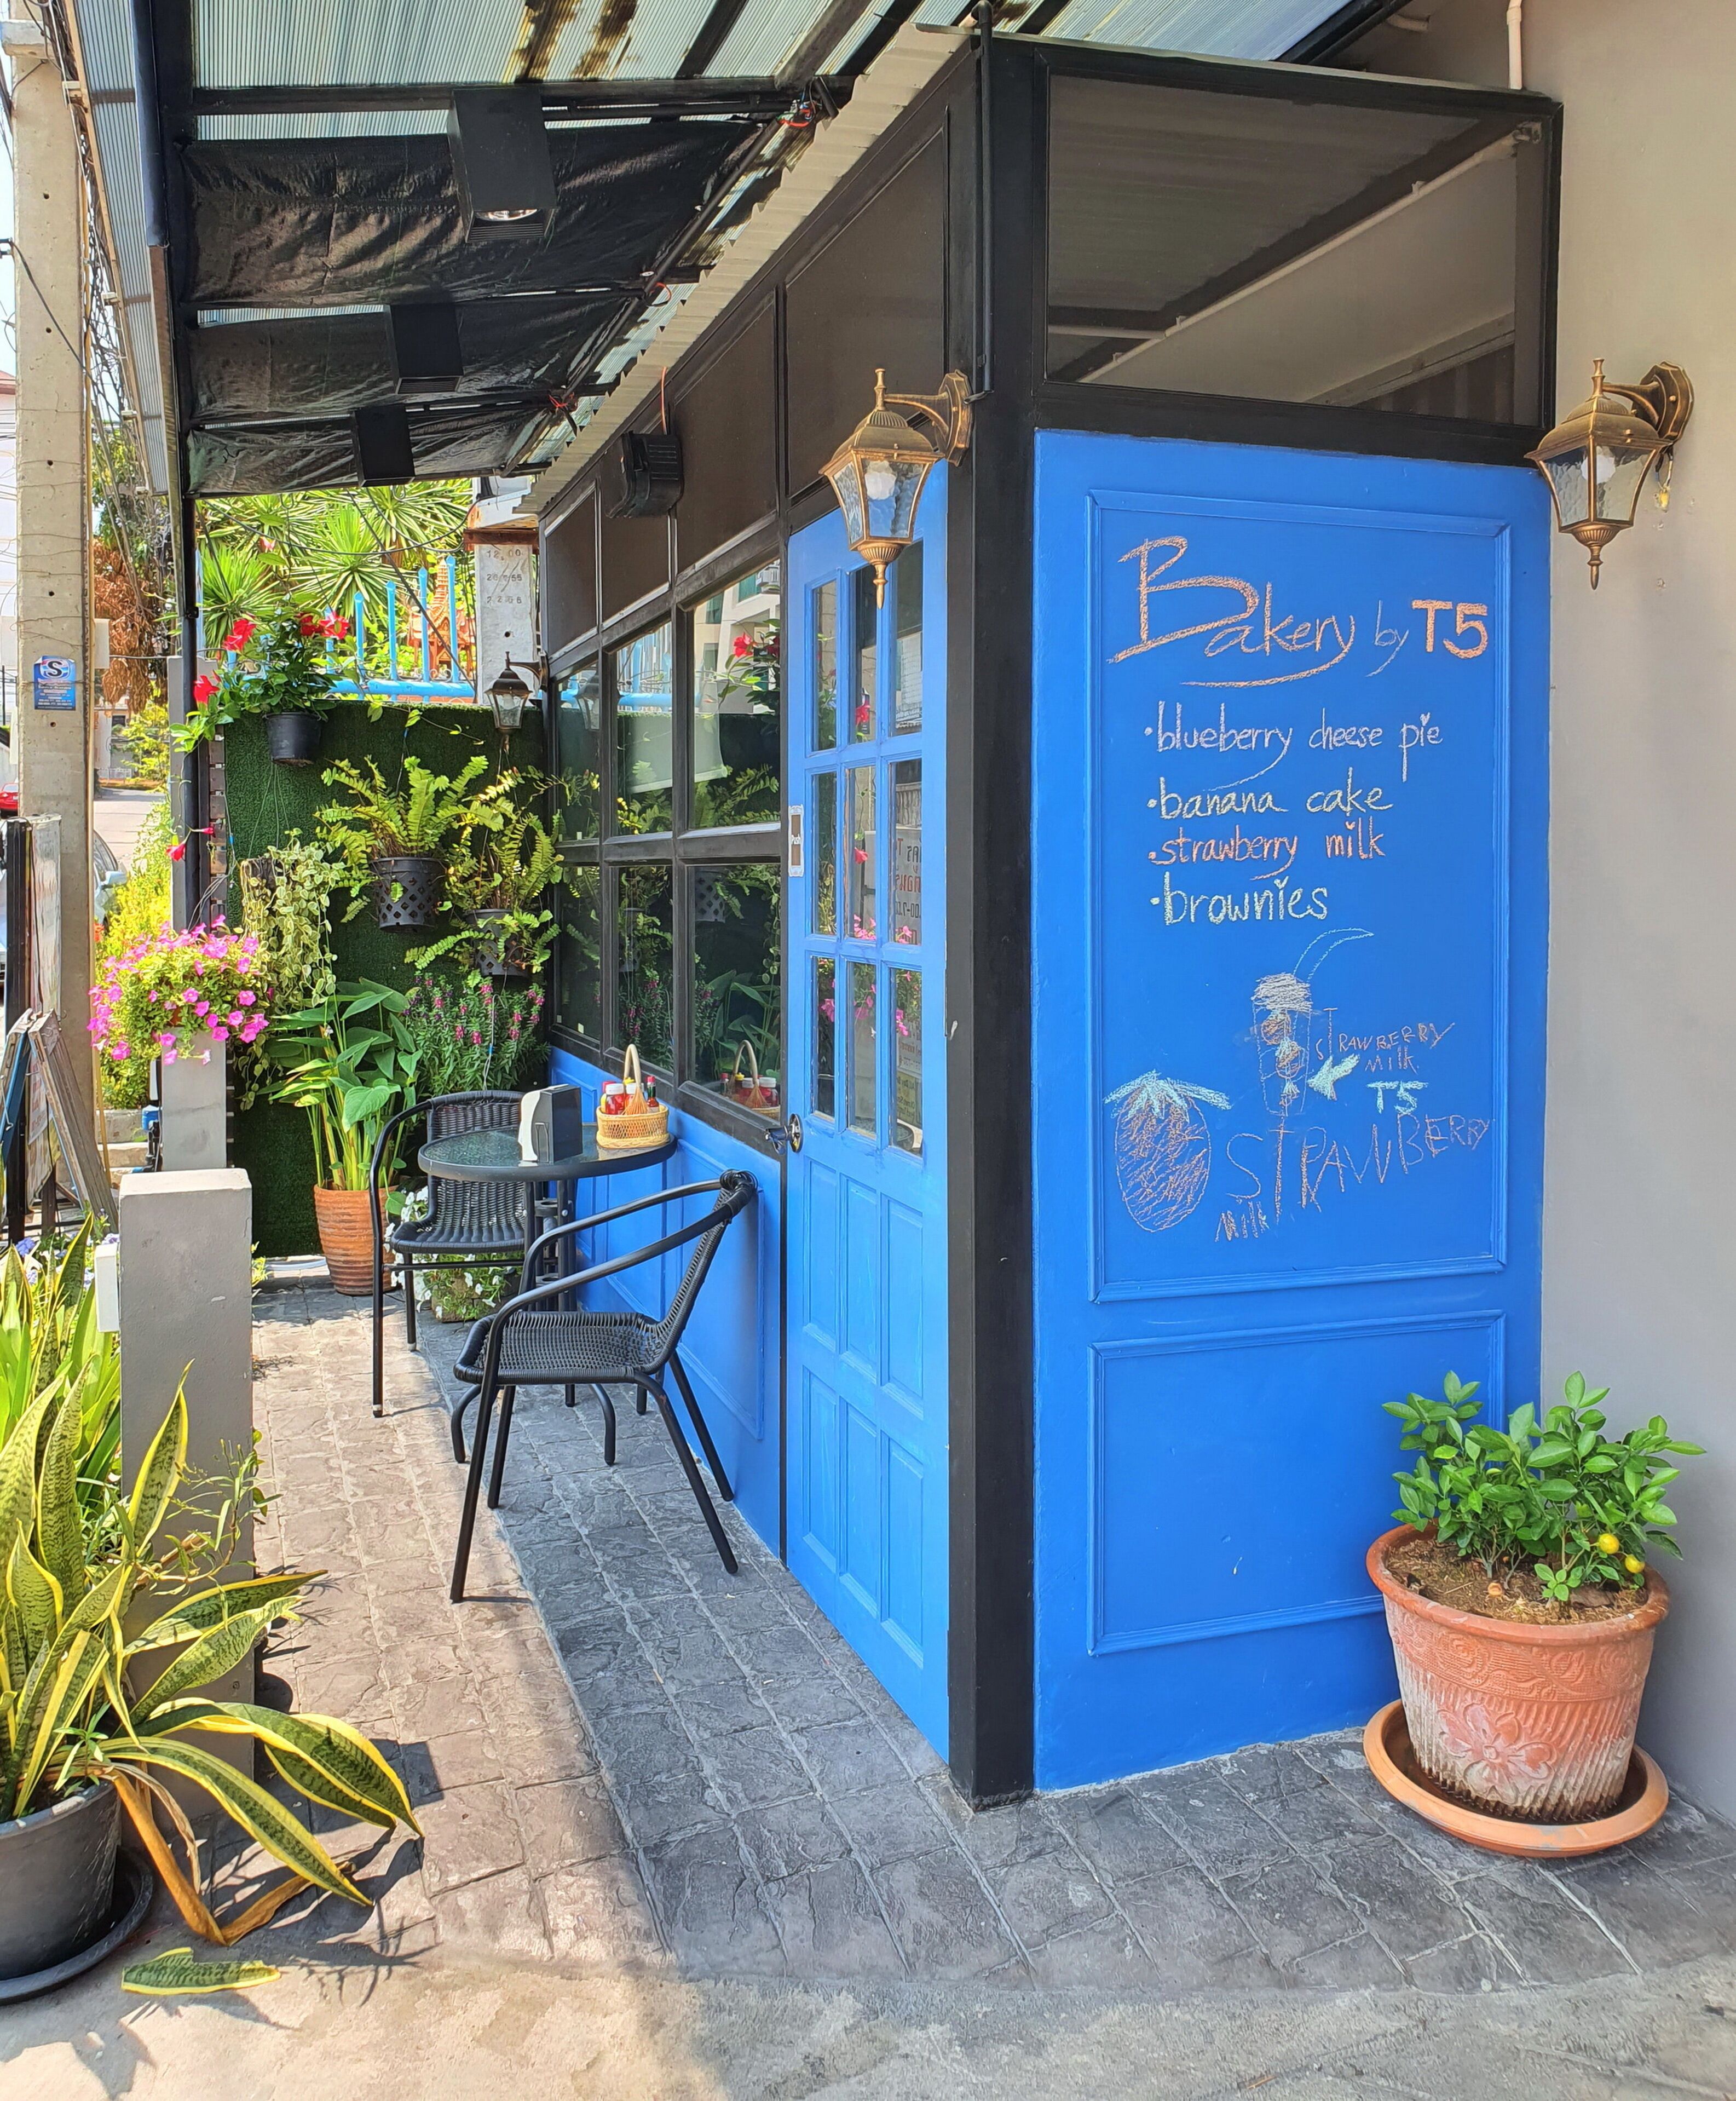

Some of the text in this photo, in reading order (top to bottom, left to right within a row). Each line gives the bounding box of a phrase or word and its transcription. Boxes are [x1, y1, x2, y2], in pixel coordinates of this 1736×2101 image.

[1106, 535, 1489, 688] Bakery by T5
[1155, 700, 1444, 792] blueberry cheese pie
[1159, 767, 1393, 819] banana cake
[1150, 815, 1386, 880] strawberry milk
[1162, 871, 1328, 925] brownies
[1367, 1080, 1428, 1114] T5
